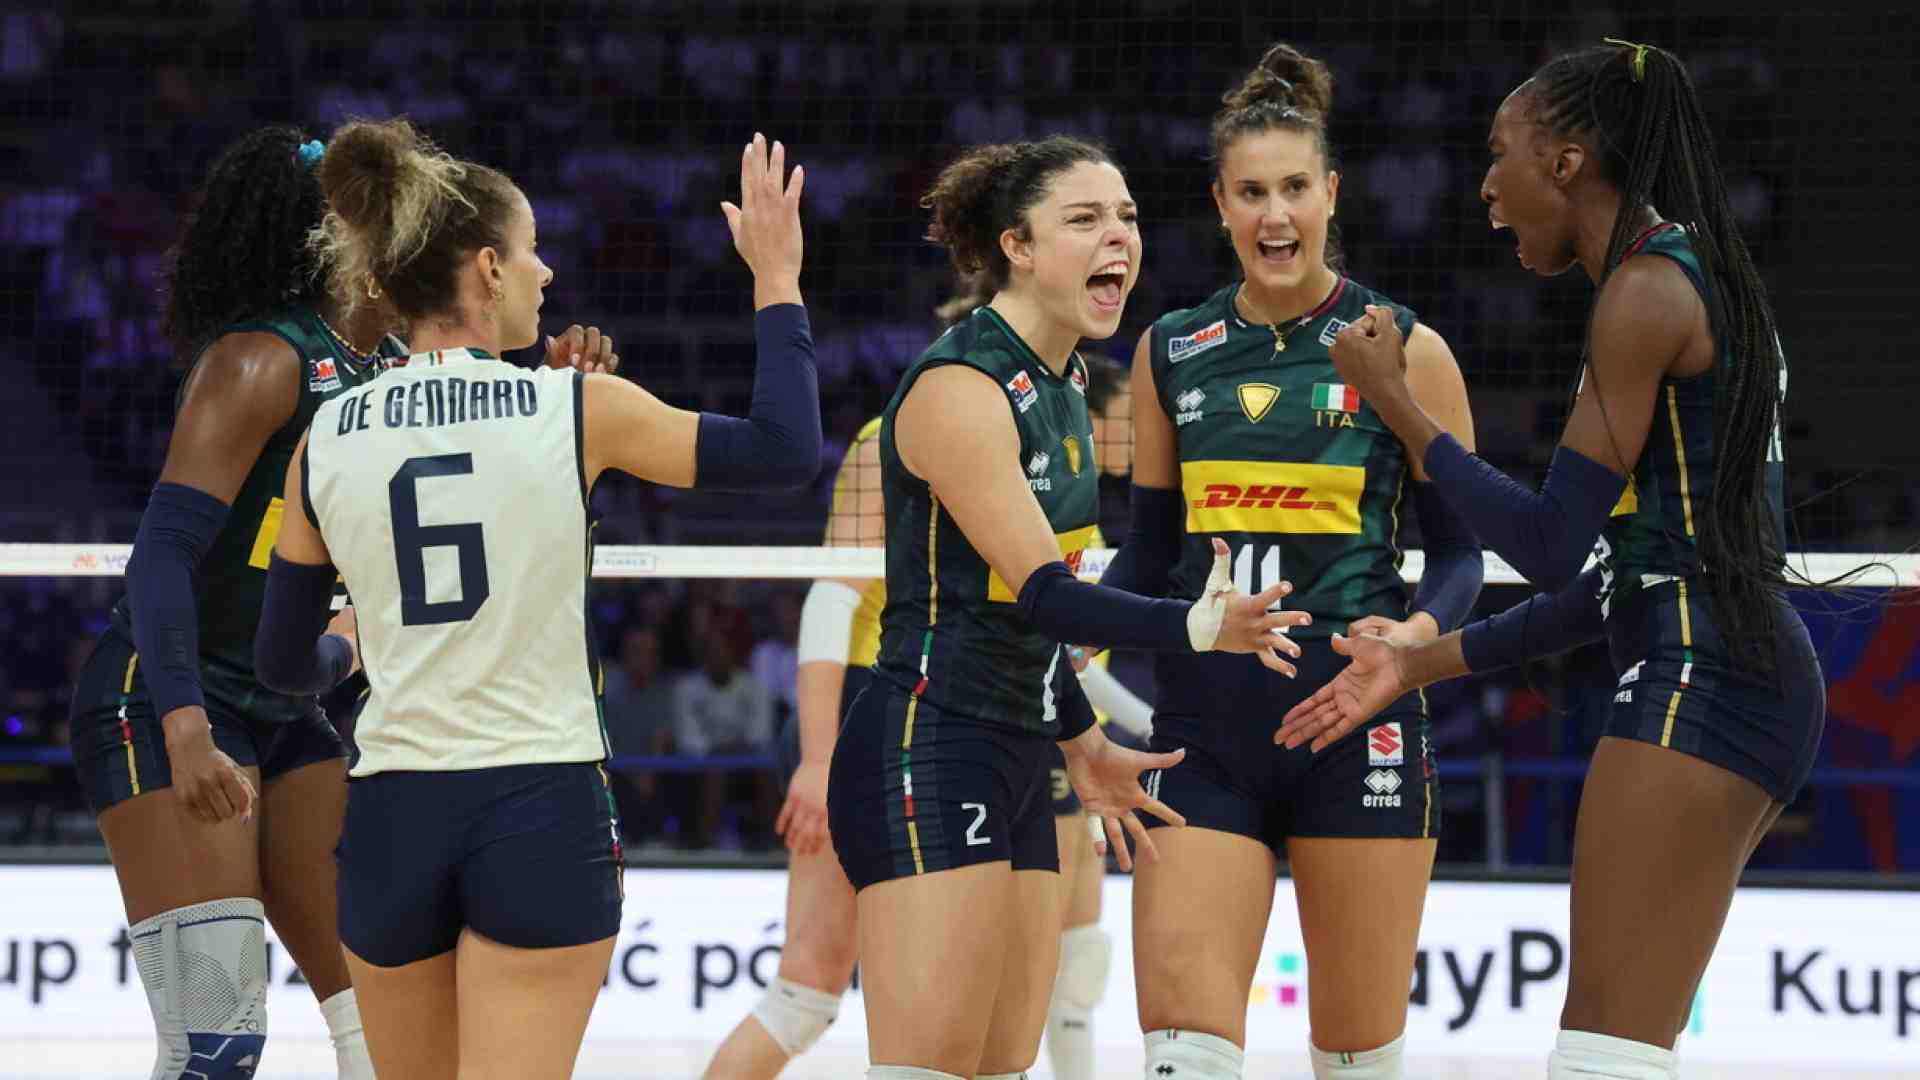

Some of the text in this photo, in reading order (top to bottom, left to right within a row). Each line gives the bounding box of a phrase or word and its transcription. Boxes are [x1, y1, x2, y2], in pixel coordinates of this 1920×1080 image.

[337, 378, 538, 436] DE GENNARO
[1316, 410, 1355, 428] ITA
[1202, 484, 1313, 510] DHL
[389, 452, 489, 626] 6
[1363, 795, 1401, 808] errea
[961, 803, 992, 845] 2
